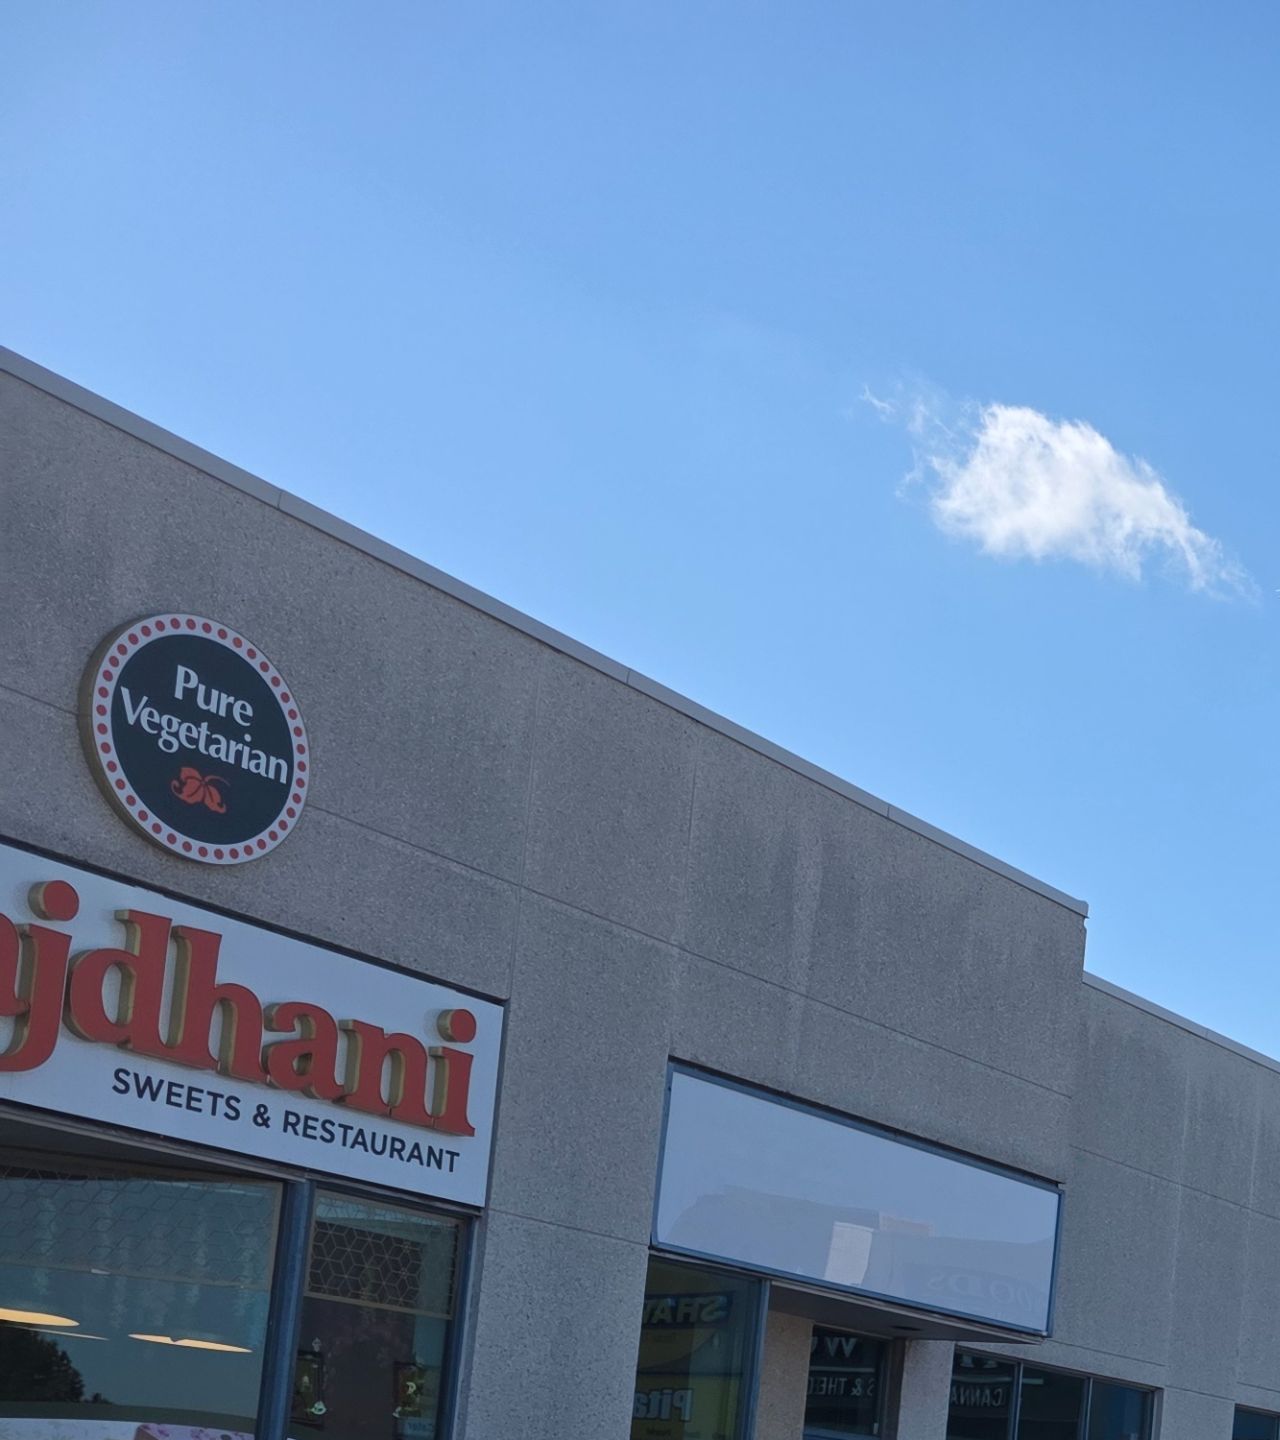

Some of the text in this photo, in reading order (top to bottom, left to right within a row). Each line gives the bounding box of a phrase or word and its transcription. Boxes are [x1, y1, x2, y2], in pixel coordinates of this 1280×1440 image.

[119, 686, 289, 784] Vegetarian
[174, 665, 253, 726] Pure
[112, 1068, 460, 1173] SWEETS & RESTAURANT
